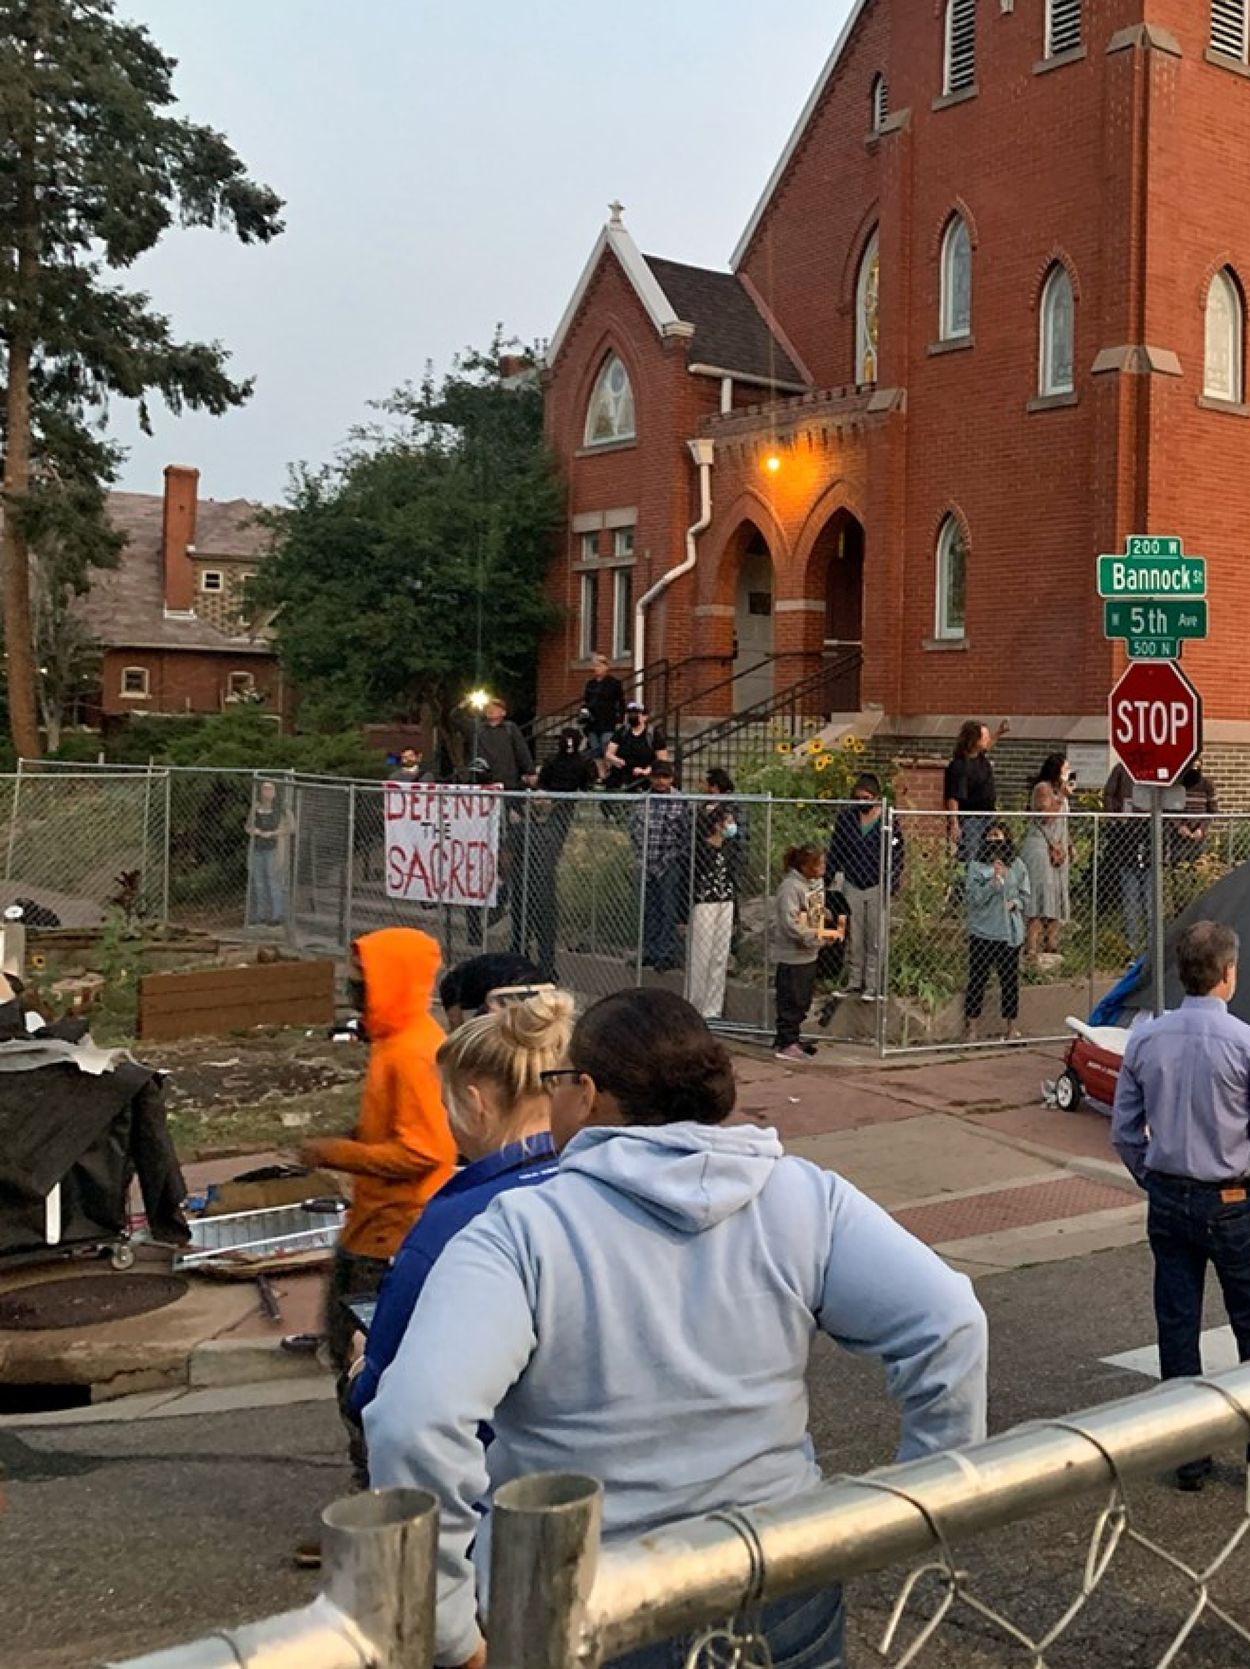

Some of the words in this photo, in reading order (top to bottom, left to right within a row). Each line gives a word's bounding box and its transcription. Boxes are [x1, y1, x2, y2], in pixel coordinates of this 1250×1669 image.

[1133, 540, 1160, 555] 200
[1168, 541, 1178, 555] W
[1113, 562, 1191, 590] Bannock
[1130, 607, 1168, 634] 5th
[1178, 613, 1198, 627] Ave
[1133, 642, 1156, 655] 500
[1161, 642, 1171, 655] N
[1116, 699, 1189, 746] STOP
[384, 782, 500, 821] DEFEND
[420, 822, 451, 840] THE
[388, 838, 495, 899] SACRED
